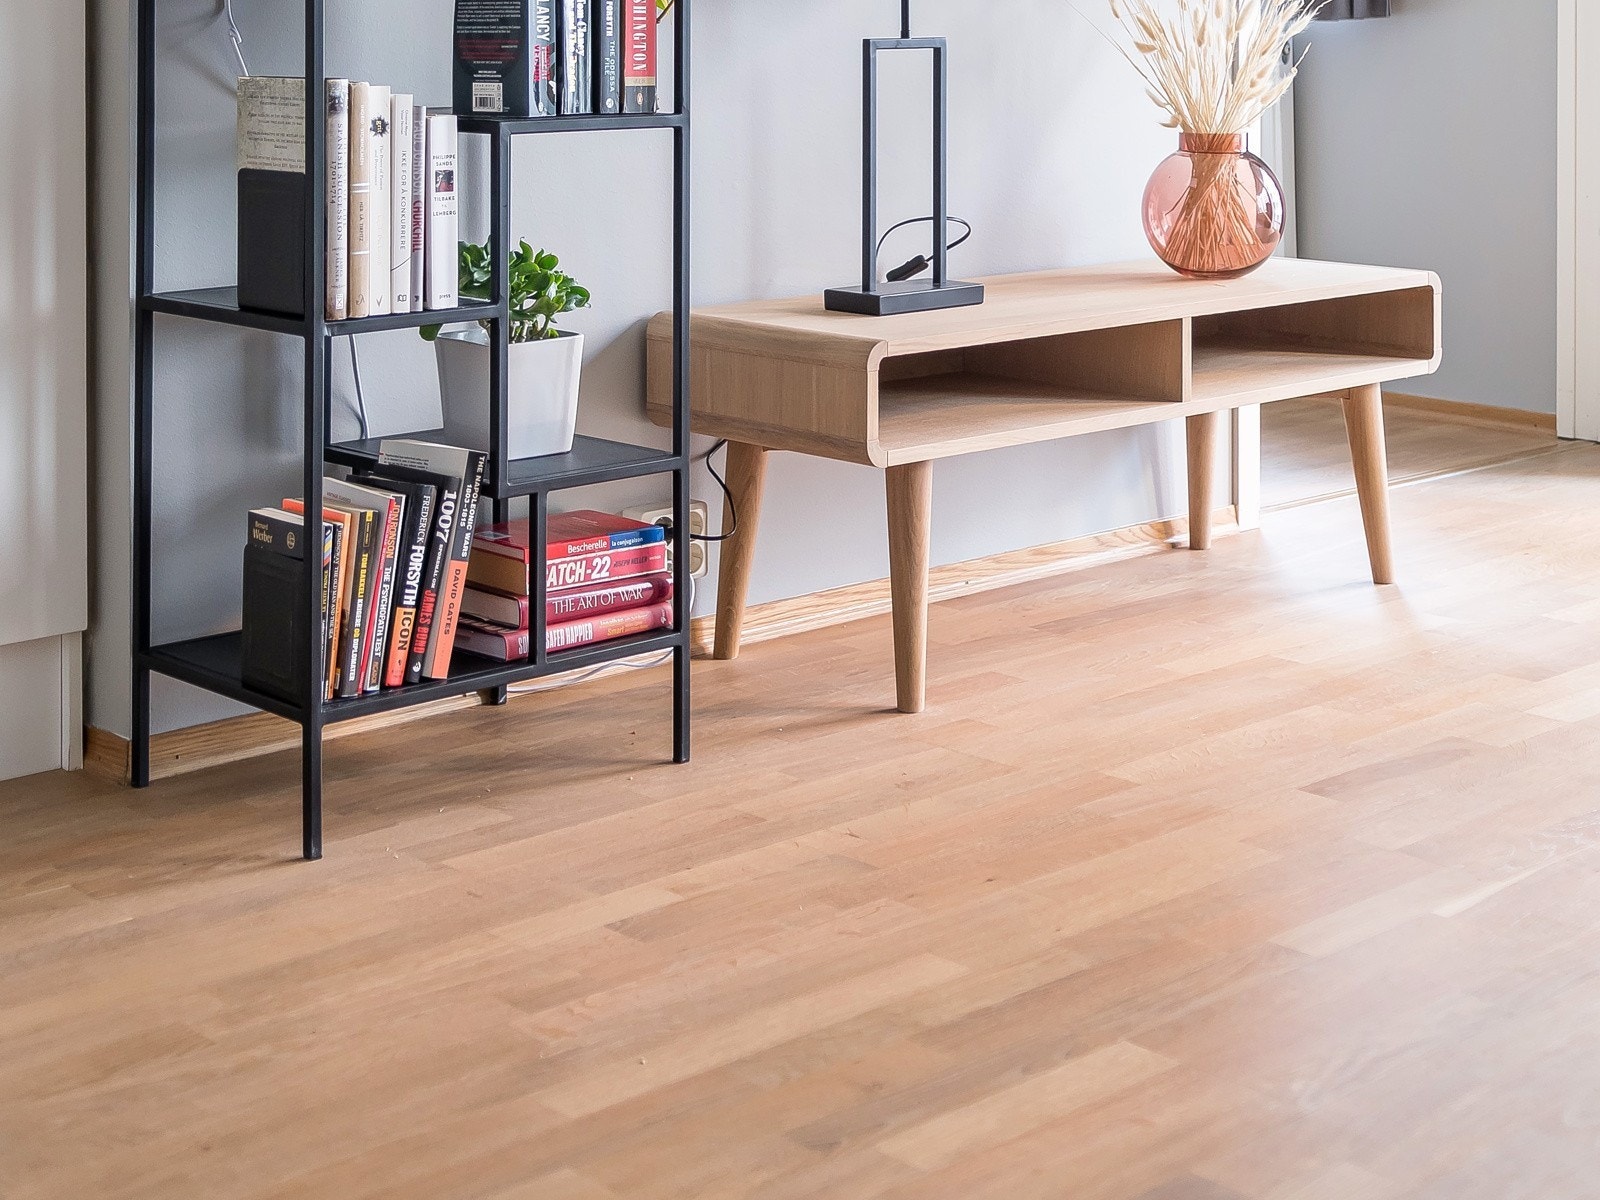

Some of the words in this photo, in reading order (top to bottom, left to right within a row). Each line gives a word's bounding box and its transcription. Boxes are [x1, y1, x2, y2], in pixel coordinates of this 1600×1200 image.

[576, 21, 587, 56] Clancy
[413, 120, 422, 144] PAUL
[413, 146, 422, 196] JOHNSON
[413, 200, 422, 252] CHURCHILL
[477, 456, 485, 474] THE
[392, 502, 400, 520] JON
[436, 490, 457, 543] 1007
[460, 484, 472, 527] 1803-1815
[466, 475, 481, 530] NAPOLEONIC
[417, 495, 431, 543] FREDERICK
[253, 528, 273, 543] Werber
[333, 529, 342, 564] HEMINGWAY
[386, 522, 398, 558] RONSON
[462, 532, 471, 558] WARS
[567, 540, 607, 554] Bescherelle
[617, 537, 644, 546] conjugaison
[403, 545, 425, 606] FORSYTH
[546, 556, 611, 587] ATCH-22
[631, 556, 647, 564] HELLER
[358, 569, 366, 598] BAKKELI
[431, 578, 437, 588] OM
[451, 568, 461, 599] DAVID
[355, 599, 363, 627] KRIGERE
[377, 584, 389, 637] PSYCHOPATH
[420, 589, 436, 624] JAMES
[552, 599, 576, 614] THE
[577, 595, 598, 610] ART
[600, 592, 616, 605] OF
[618, 587, 644, 602] WAR
[354, 628, 360, 638] OG
[398, 611, 413, 651] ICON
[444, 602, 454, 635] GATES
[607, 627, 625, 636] Smart
[413, 626, 429, 654] BOND
[546, 628, 565, 649] SAFER
[566, 622, 594, 644] HAPPIER
[349, 638, 359, 681] DIPLOMATER
